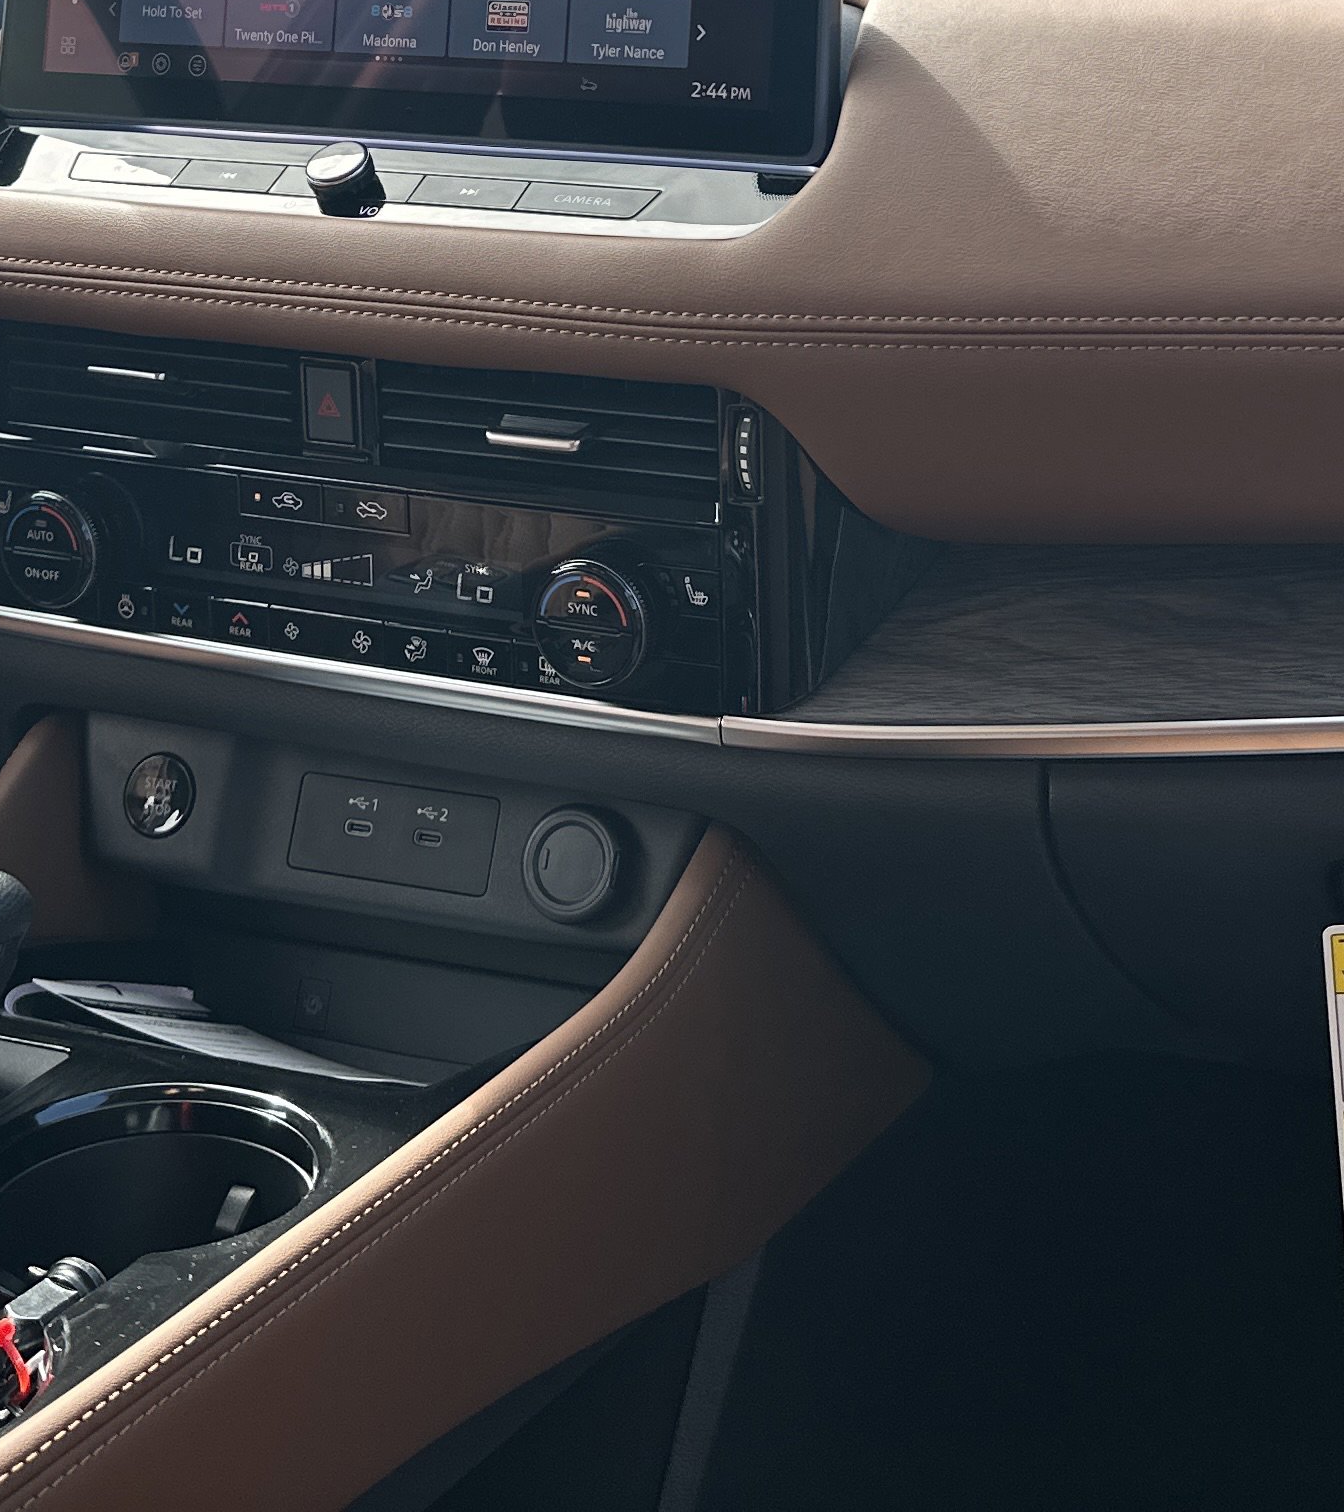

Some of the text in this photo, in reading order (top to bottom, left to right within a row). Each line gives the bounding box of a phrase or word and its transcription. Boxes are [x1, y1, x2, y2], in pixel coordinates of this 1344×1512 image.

[142, 5, 202, 19] Hold To Set
[490, 2, 527, 13] Classic
[626, 8, 638, 18] the
[606, 13, 652, 34] highway
[235, 29, 274, 43] Twenty
[277, 30, 298, 43] One
[363, 34, 416, 48] Madonna
[473, 39, 540, 56] Don Henley
[592, 44, 664, 59] Tyler Nance
[691, 81, 751, 100] 2:44 PM
[553, 193, 612, 207] CAMERA
[27, 530, 54, 541] AUTO
[240, 534, 262, 545] SYNC
[240, 562, 263, 572] REAR
[568, 603, 597, 616] SYNC
[172, 616, 192, 628] REAR
[229, 626, 251, 637] REAR
[572, 640, 596, 652] A/C
[472, 665, 497, 676] FRONT
[540, 675, 560, 685] REAR
[145, 776, 178, 791] START
[372, 799, 380, 812] 1
[440, 809, 449, 822] 2
